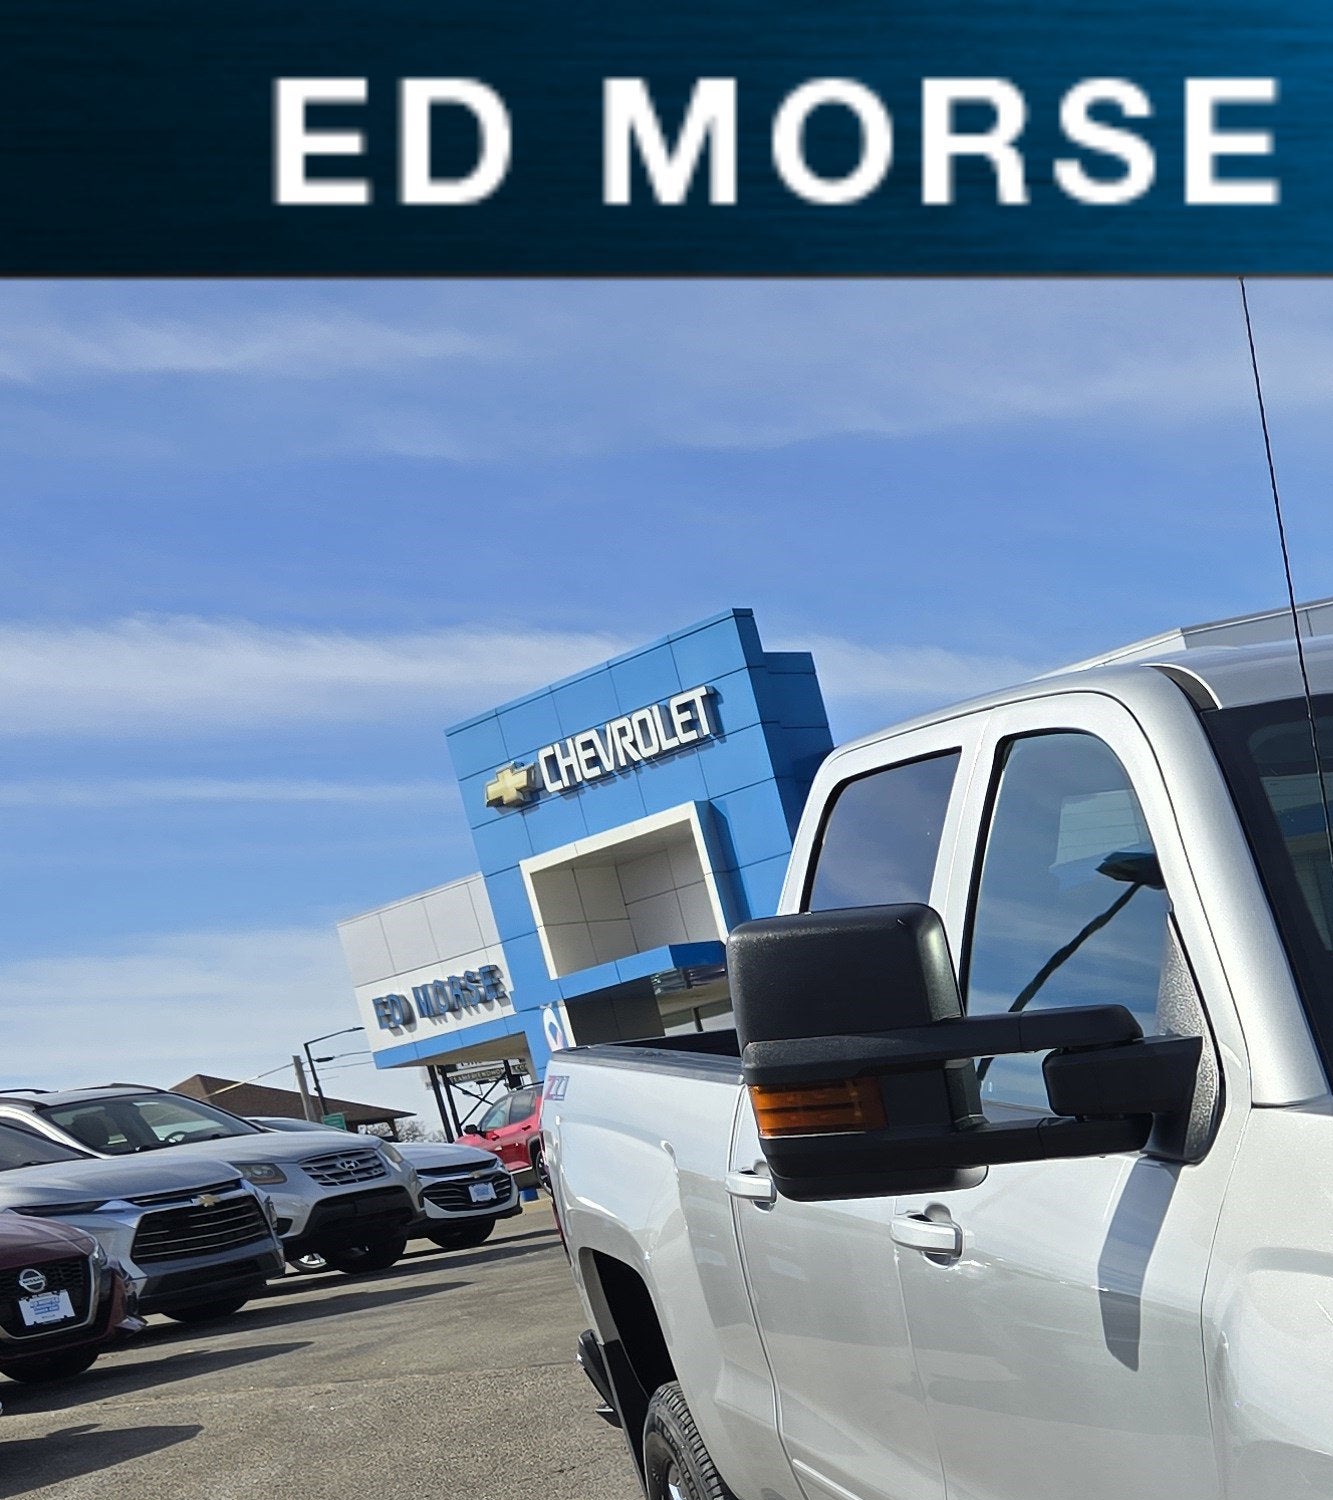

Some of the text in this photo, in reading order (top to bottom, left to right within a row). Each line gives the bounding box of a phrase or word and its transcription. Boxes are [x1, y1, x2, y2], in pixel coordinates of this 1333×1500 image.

[537, 685, 711, 794] CHEVROLET
[372, 964, 501, 1030] ED MORSE
